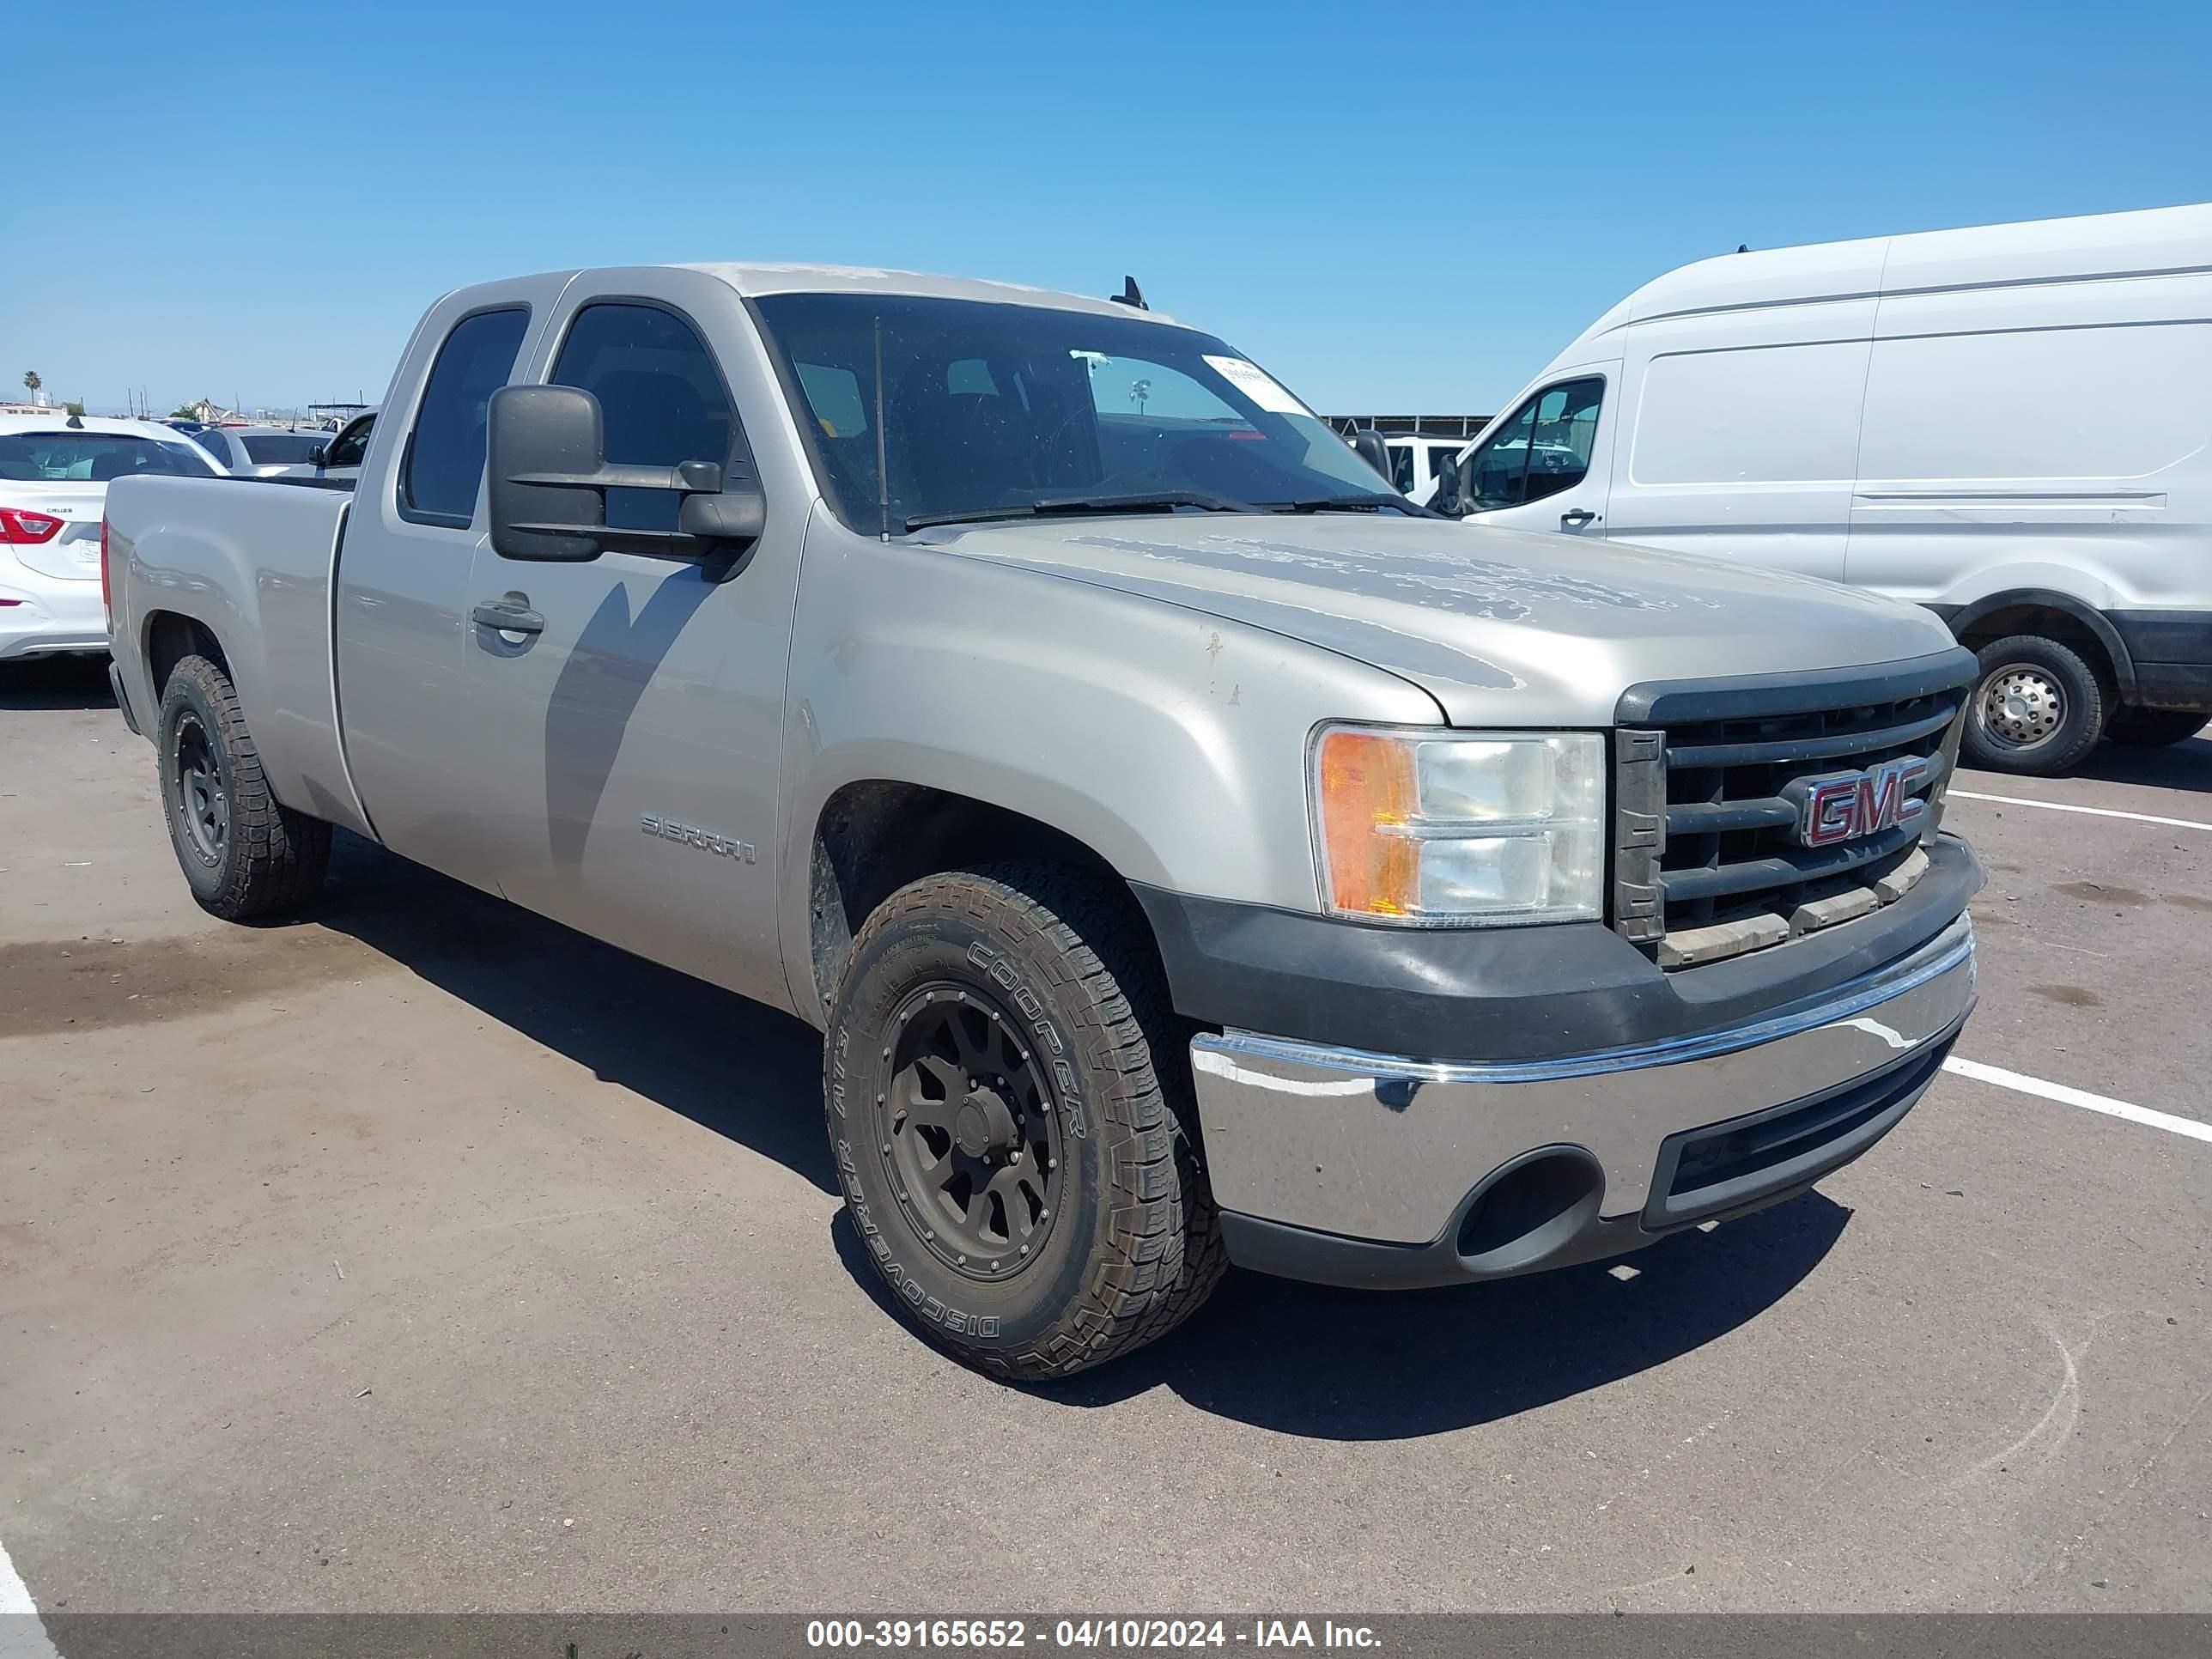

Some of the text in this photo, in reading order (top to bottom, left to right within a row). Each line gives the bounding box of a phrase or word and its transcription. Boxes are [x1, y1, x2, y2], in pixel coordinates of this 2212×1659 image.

[640, 812, 741, 860] SIERRA
[1802, 757, 1927, 848] GMC
[967, 941, 1086, 1139] COOPER
[837, 1139, 1000, 1338] DISCOVERER
